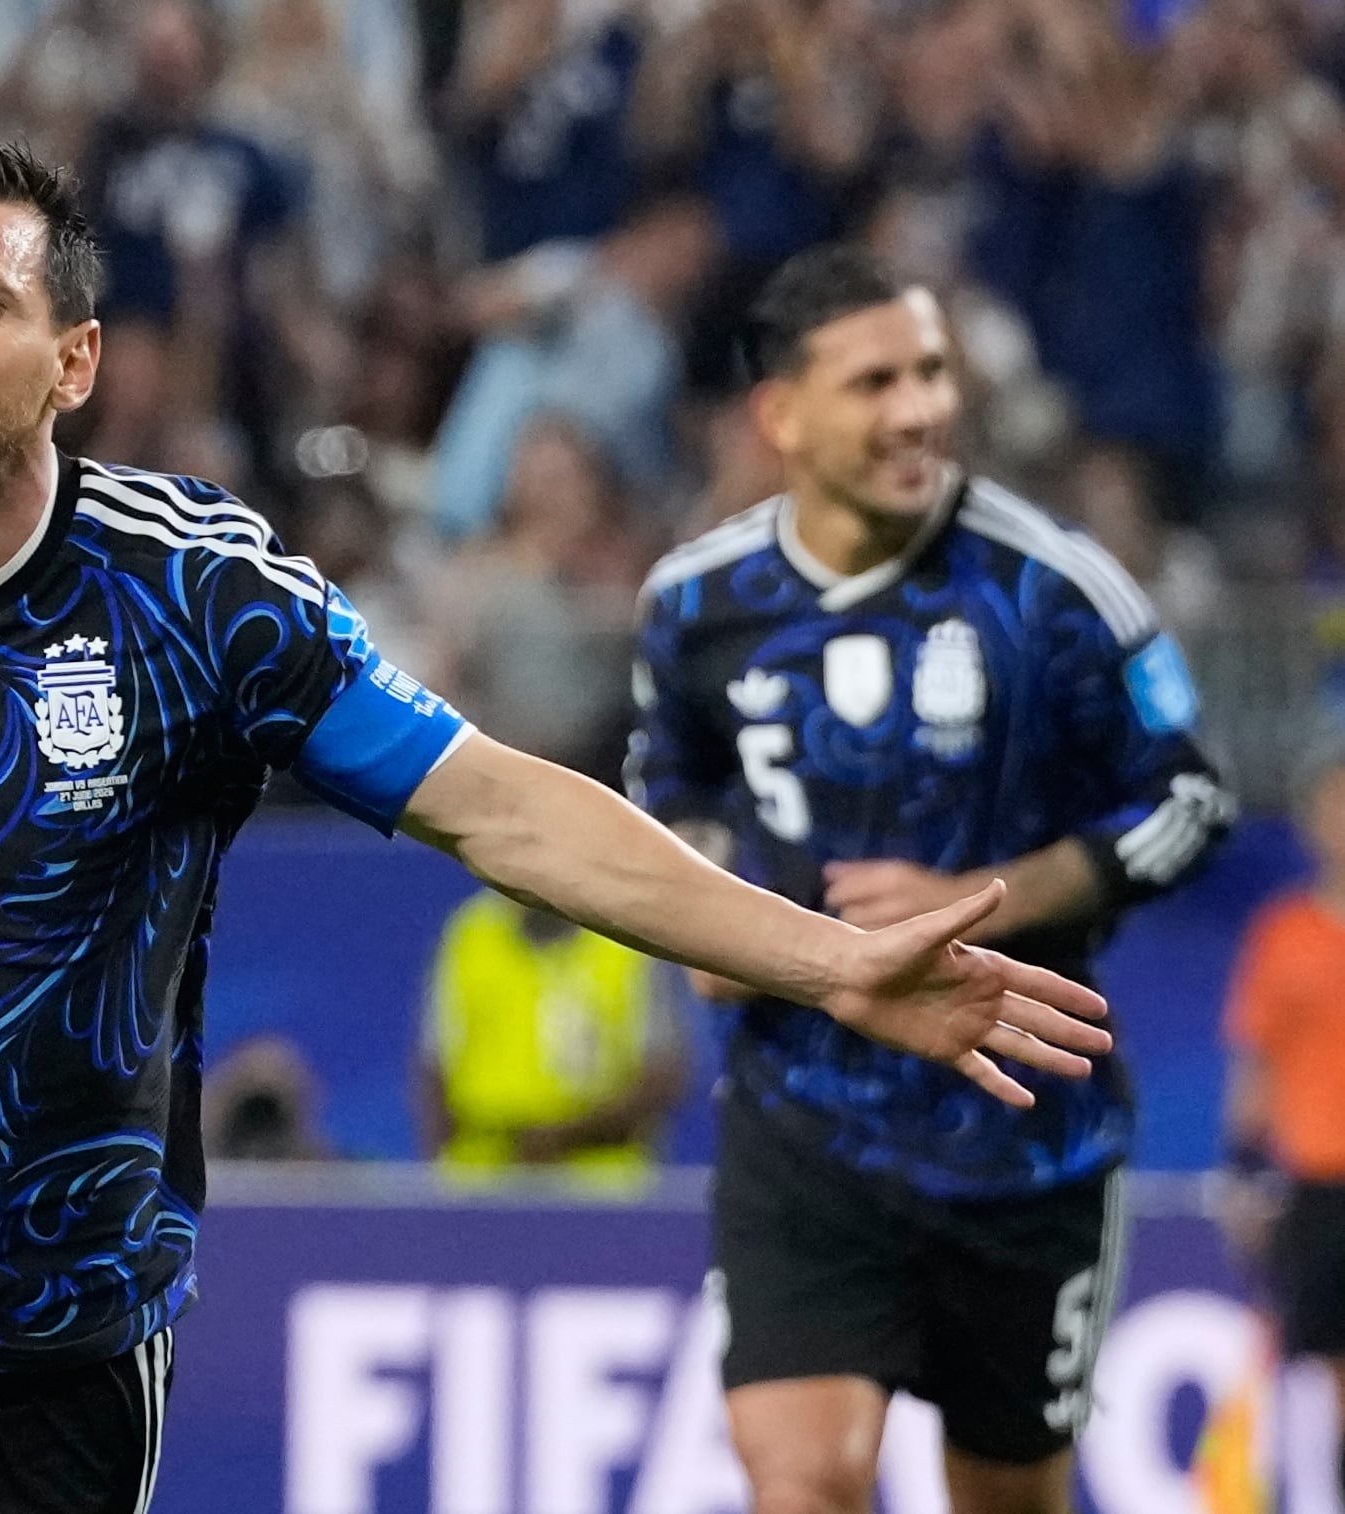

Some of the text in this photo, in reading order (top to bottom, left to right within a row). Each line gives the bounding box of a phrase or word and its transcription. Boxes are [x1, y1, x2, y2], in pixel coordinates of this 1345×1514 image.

[56, 690, 104, 736] AFA
[93, 786, 114, 799] 2026
[736, 722, 812, 843] 5
